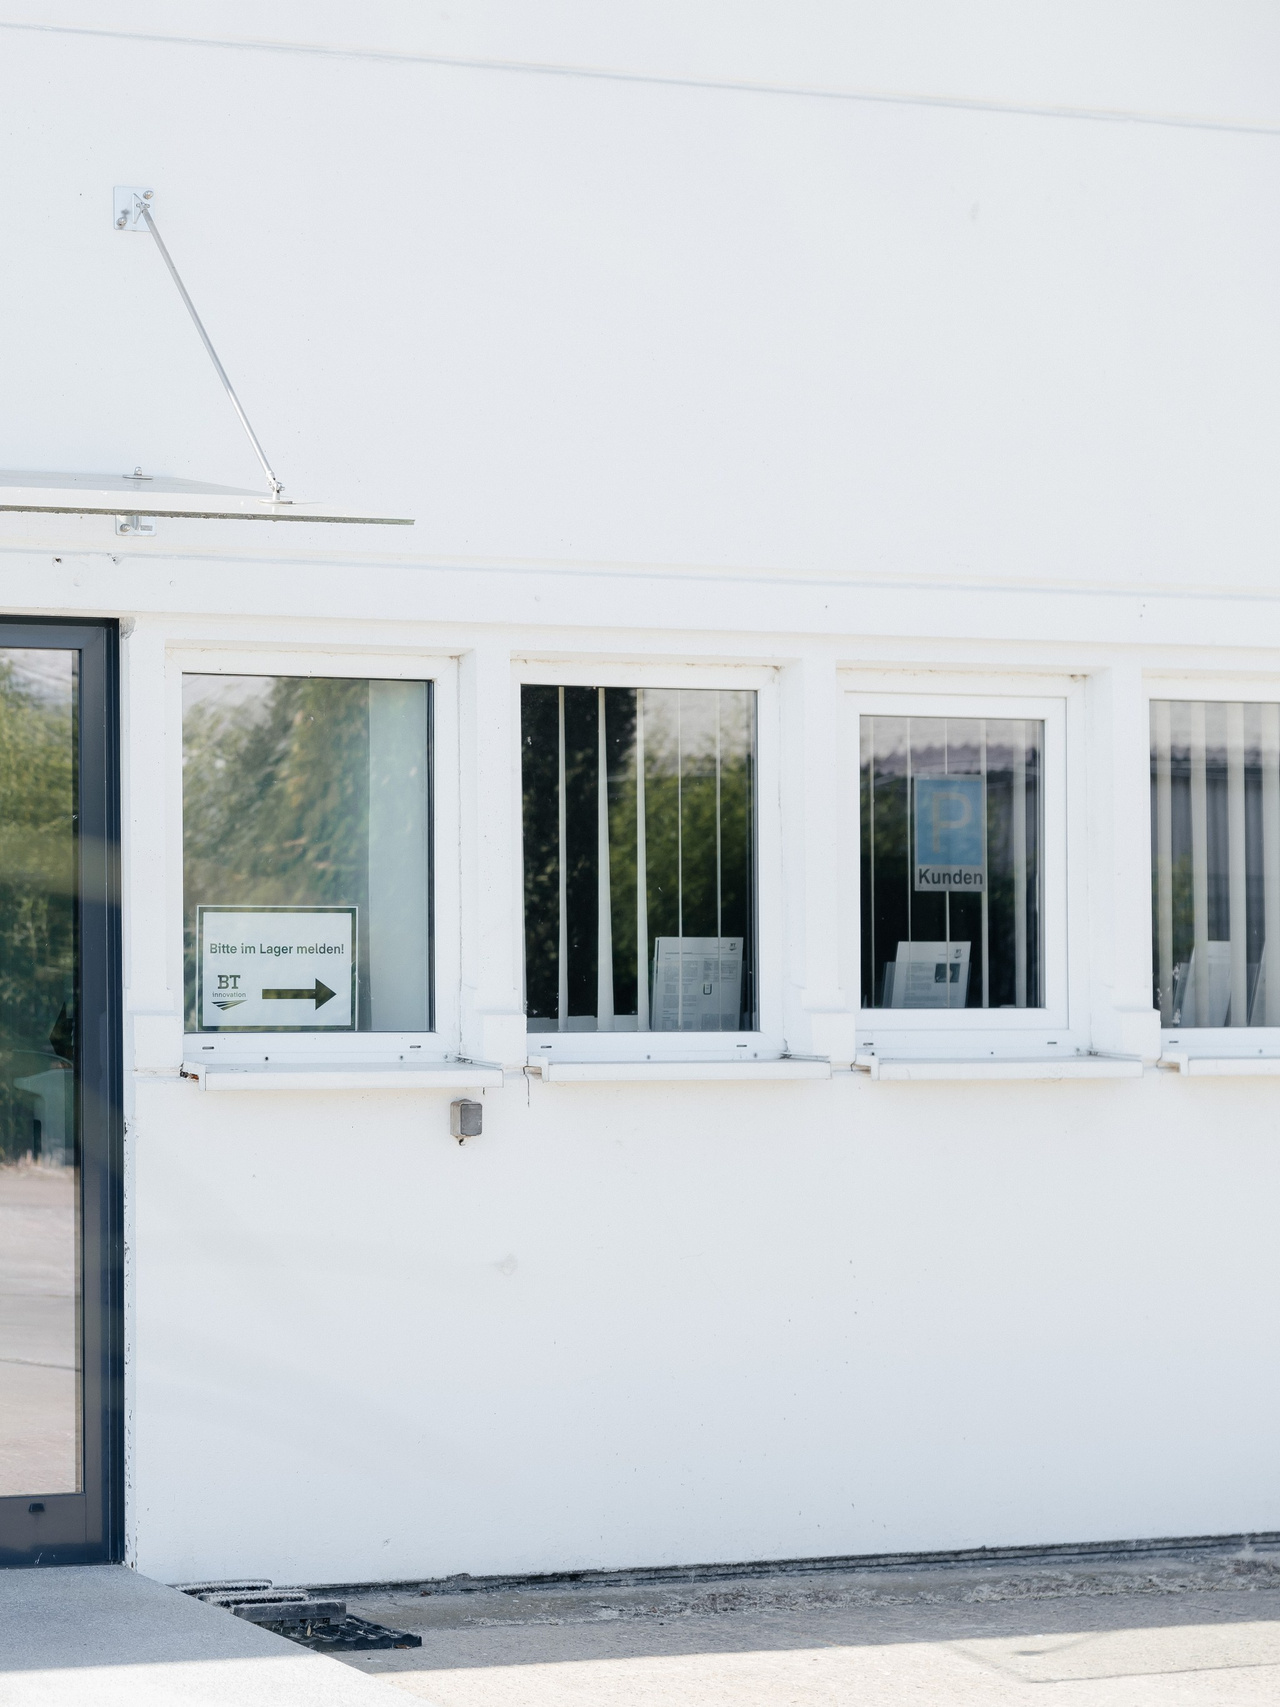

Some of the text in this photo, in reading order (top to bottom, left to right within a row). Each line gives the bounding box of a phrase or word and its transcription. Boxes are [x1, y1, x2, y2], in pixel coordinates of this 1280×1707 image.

[919, 868, 984, 885] Kunden
[209, 943, 345, 957] Bitte im Lager melden!
[217, 974, 241, 990] BT
